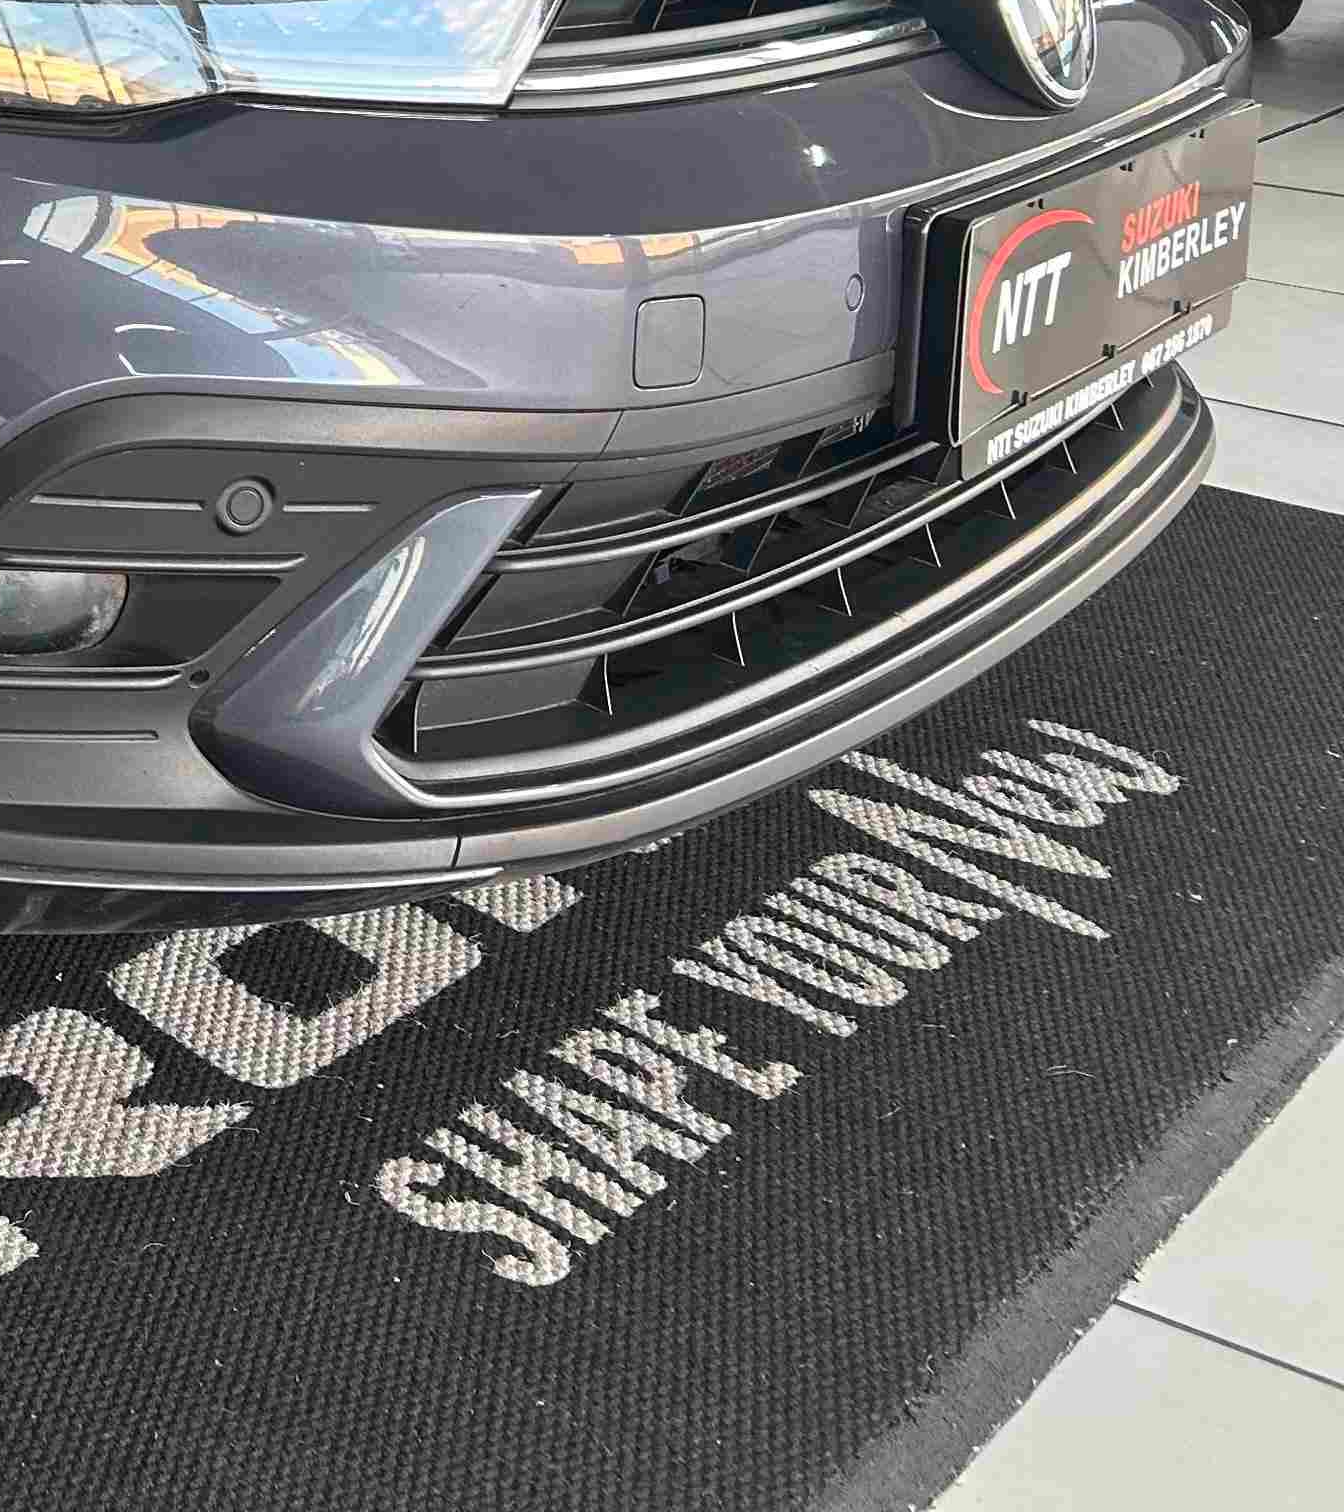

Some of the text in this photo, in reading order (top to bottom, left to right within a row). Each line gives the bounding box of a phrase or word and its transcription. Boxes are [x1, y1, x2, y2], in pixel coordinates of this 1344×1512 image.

[1117, 200, 1247, 299] KIMBERLEY
[1121, 181, 1201, 254] SUZUKI
[992, 251, 1072, 354] NTT
[987, 428, 1014, 465] NTT
[1013, 398, 1065, 450] SUZUKI
[1064, 359, 1137, 420] KIMBERLEY
[374, 718, 1182, 1288] SHAPE YOUR New
